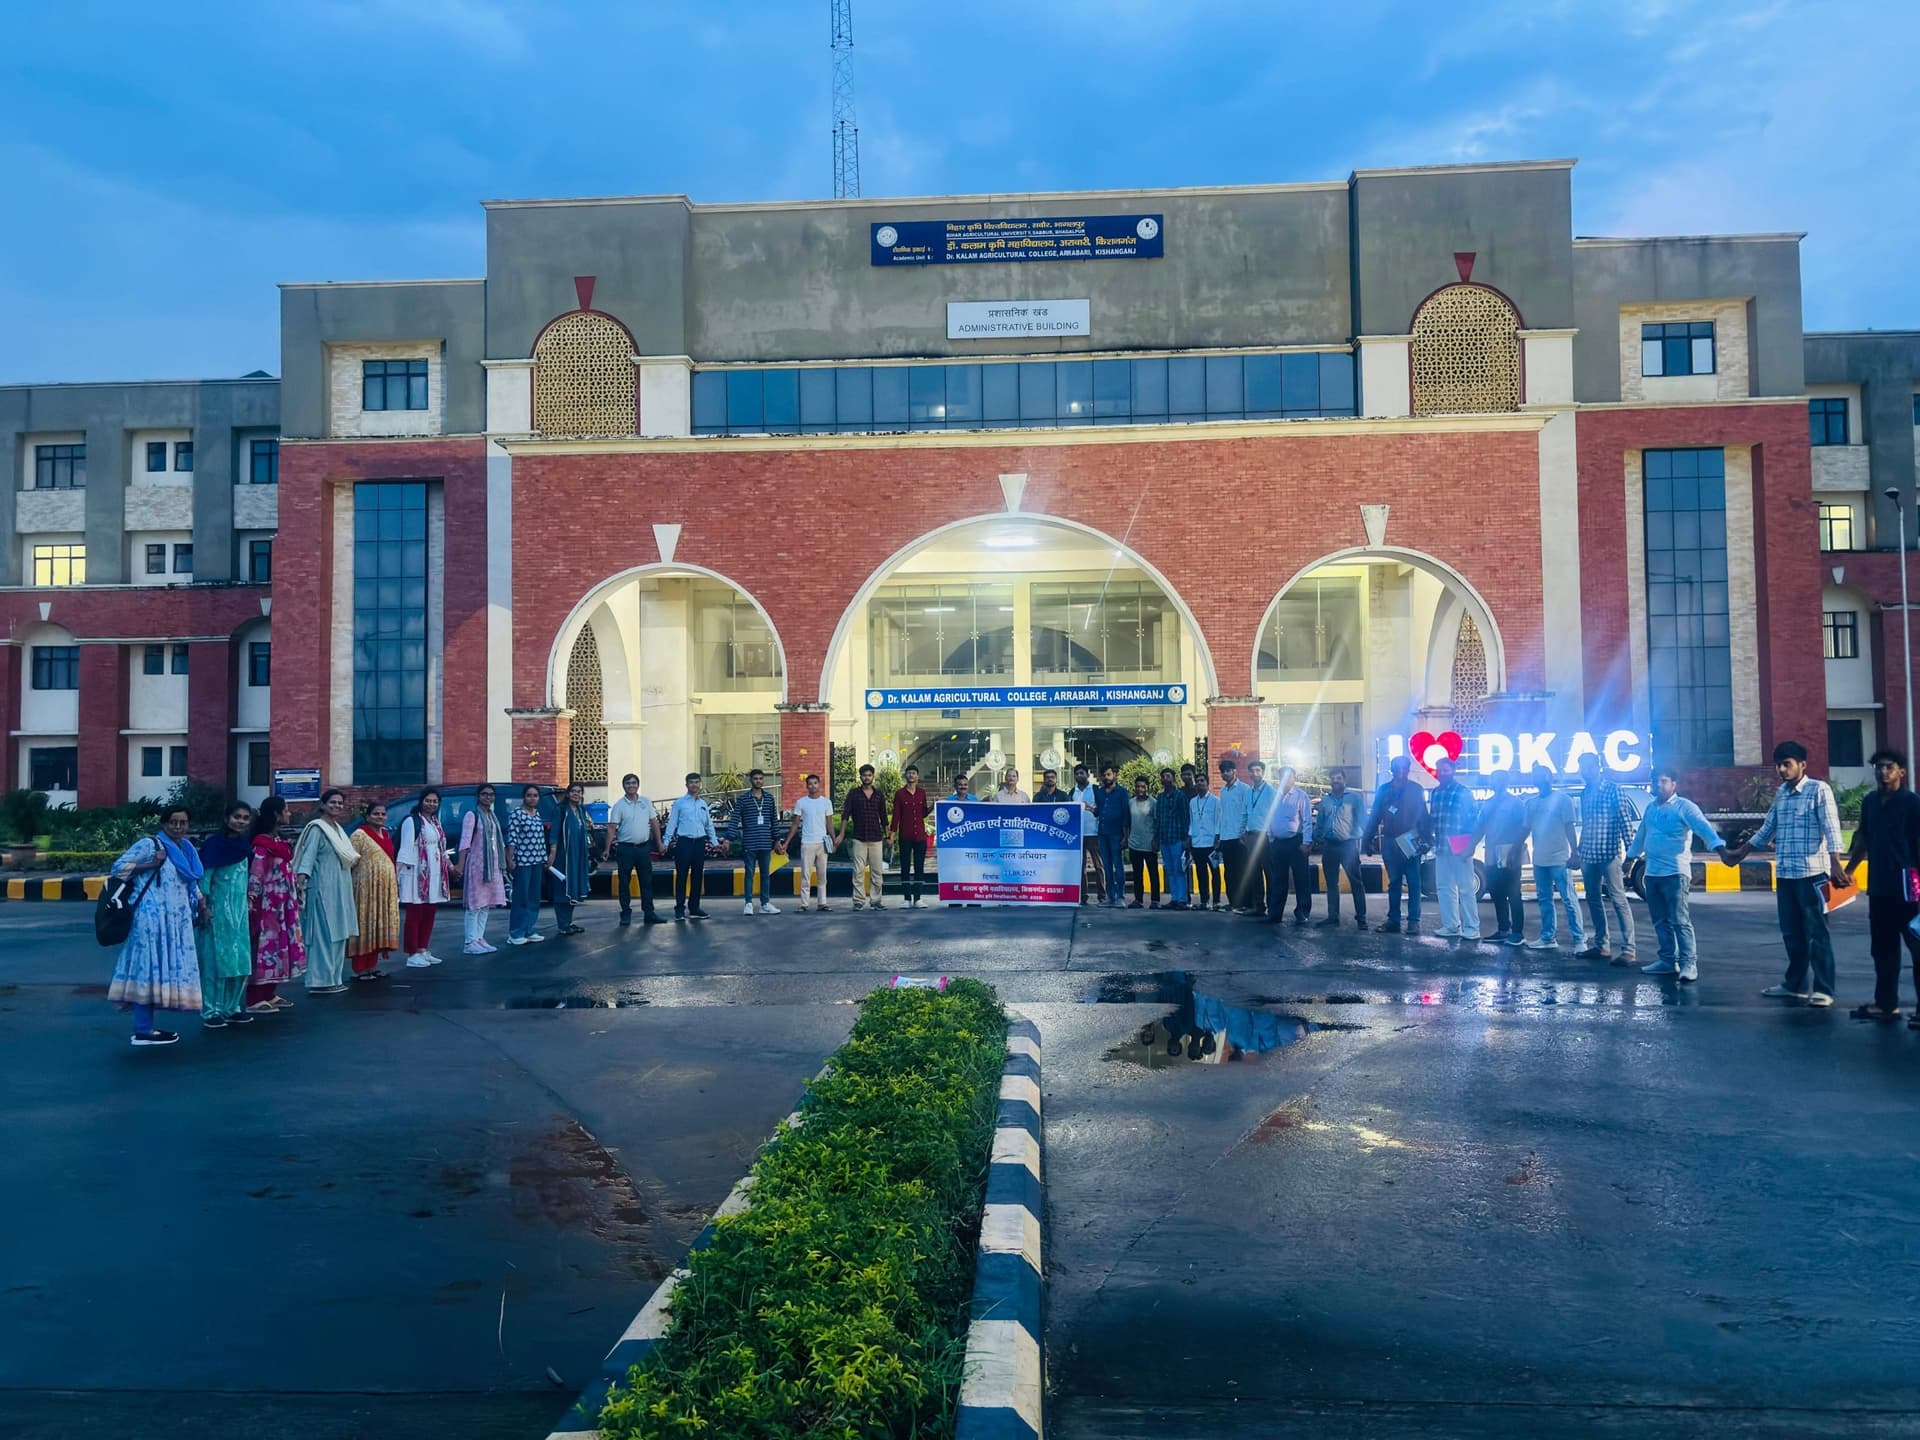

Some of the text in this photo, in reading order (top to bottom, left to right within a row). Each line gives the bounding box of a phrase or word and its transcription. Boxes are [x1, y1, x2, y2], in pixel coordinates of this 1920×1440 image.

[956, 252, 978, 260] KALAM
[979, 251, 1026, 259] AGRICULTURAL
[988, 306, 1048, 319] प्रशासनिक खंड
[958, 321, 1079, 333] ADMINISTRATIVE BUILDING
[887, 694, 899, 704] Dr.
[901, 693, 931, 703] KALAM
[933, 692, 1001, 703] AGRICULTURAL
[1106, 689, 1164, 700] KISHANGANJ
[1478, 730, 1641, 776] DKAC
[939, 815, 1078, 845] सांस्कृतिक एवं साहित्यिक इकाई
[999, 852, 1016, 860] भारत
[1018, 850, 1047, 860] अभियान
